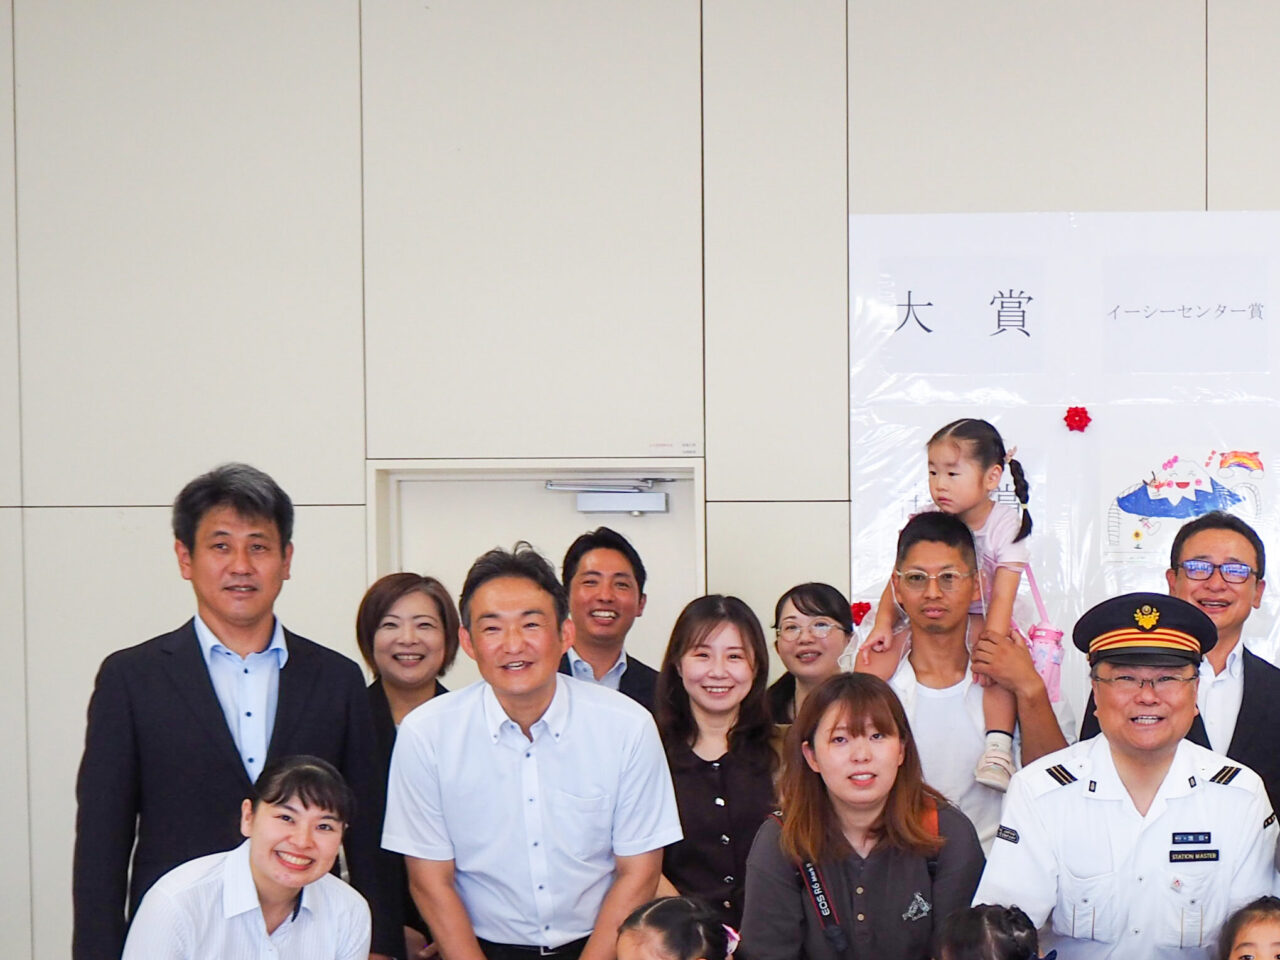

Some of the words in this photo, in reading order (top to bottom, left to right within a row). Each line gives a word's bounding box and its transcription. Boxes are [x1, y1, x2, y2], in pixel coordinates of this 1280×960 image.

[1107, 300, 1265, 322] イーシーセンター賞
[811, 882, 823, 895] R6
[816, 894, 831, 916] EOS
